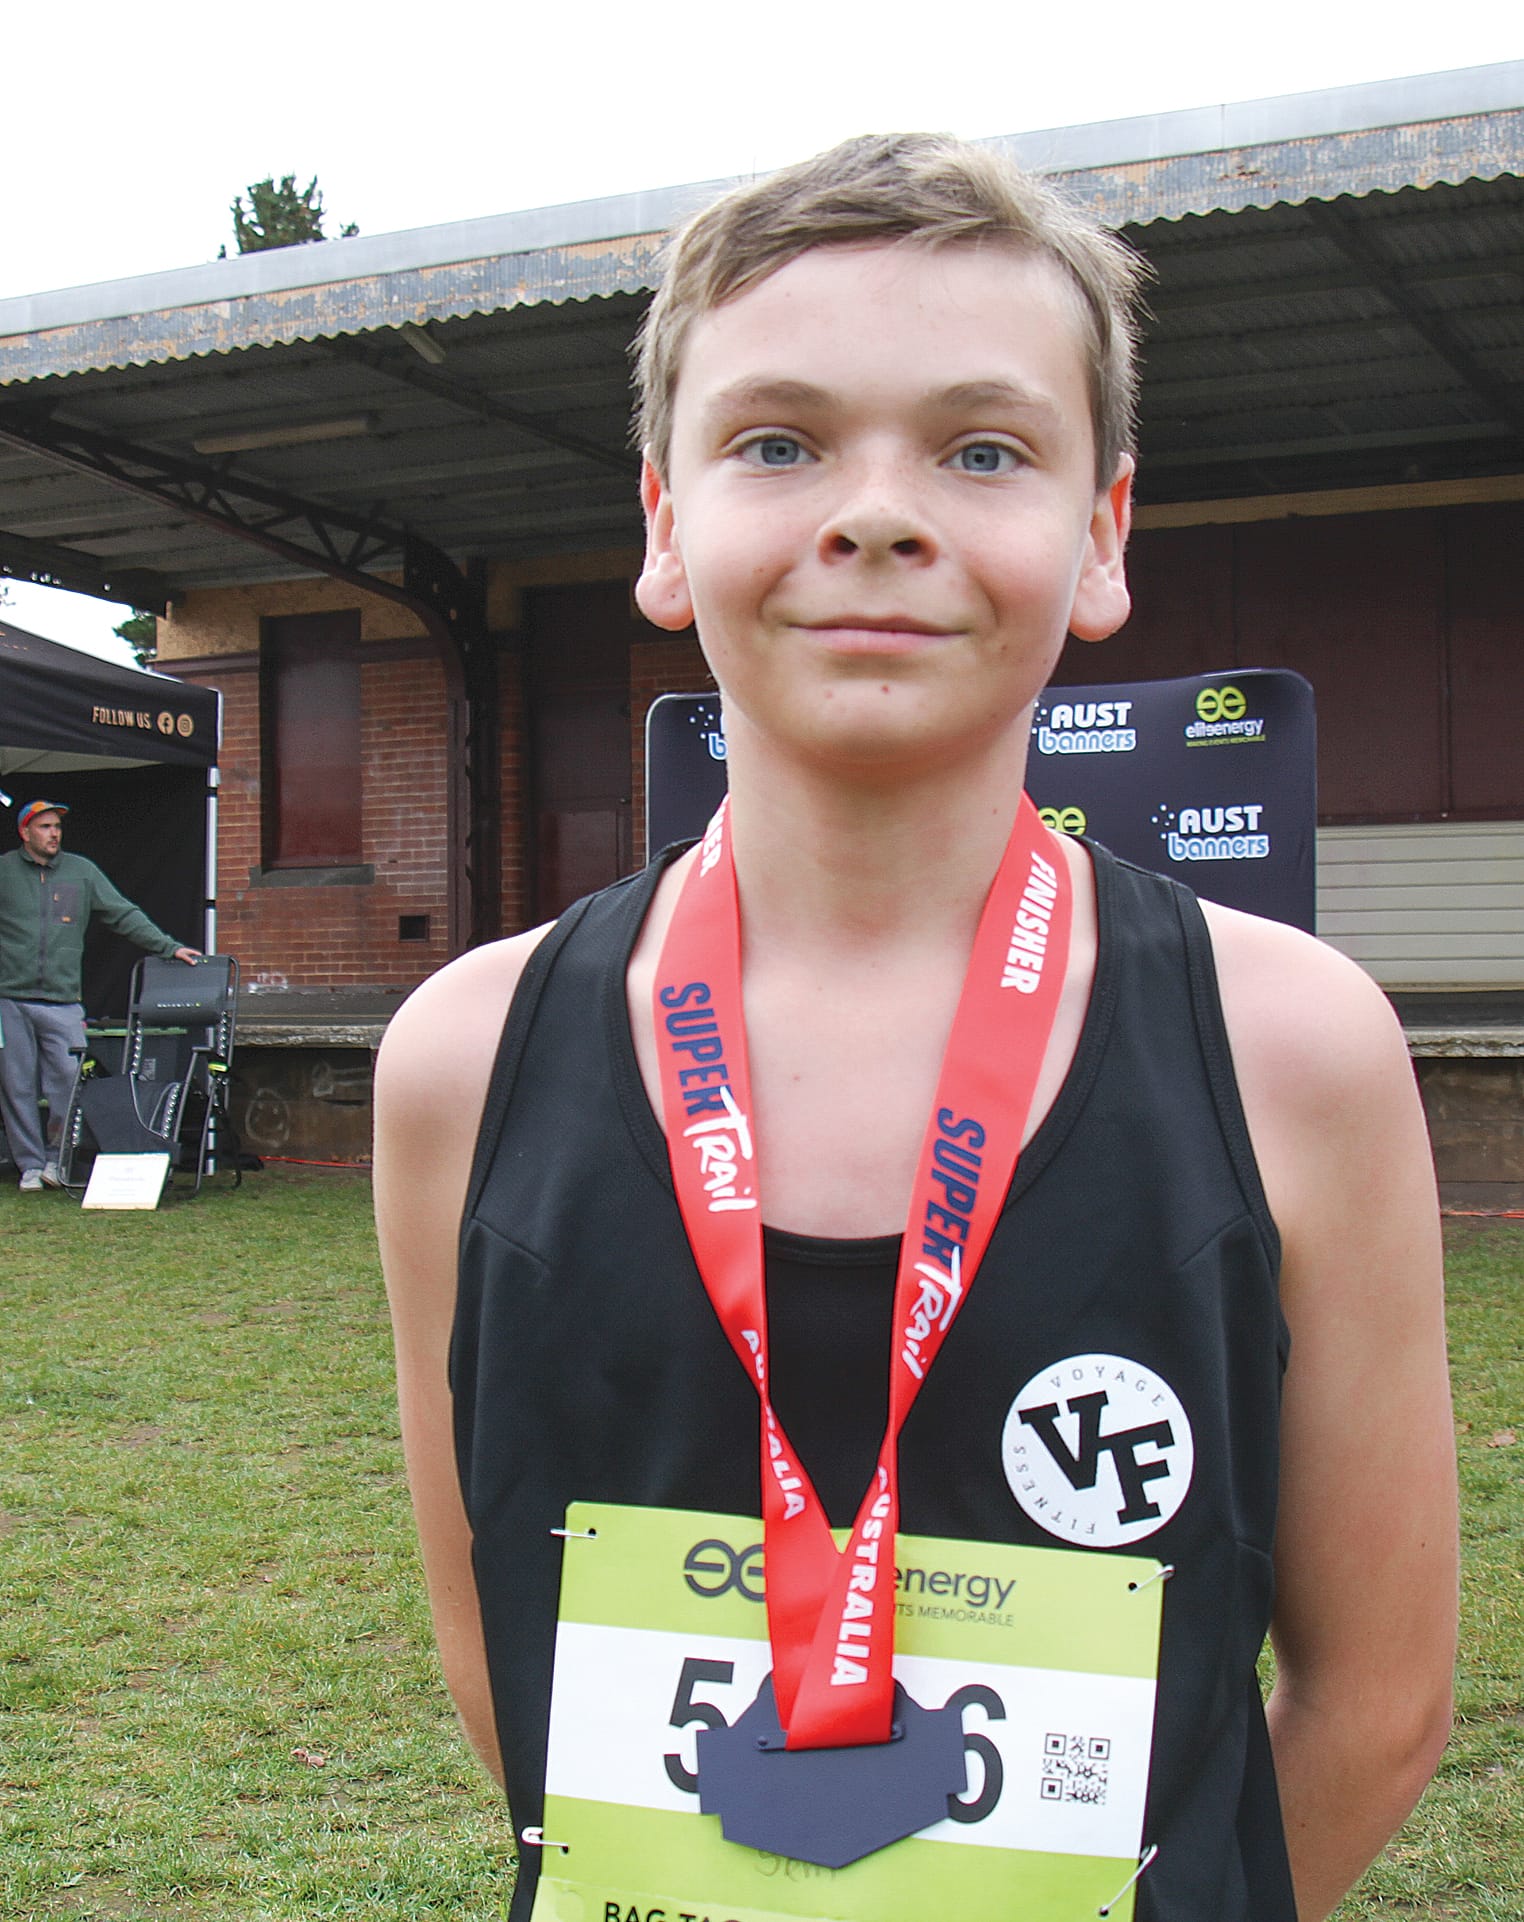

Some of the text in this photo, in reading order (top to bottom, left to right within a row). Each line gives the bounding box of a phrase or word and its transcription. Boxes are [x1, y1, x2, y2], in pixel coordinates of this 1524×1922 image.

[92, 706, 151, 729] FOLLOW US
[1051, 702, 1132, 729] AUST
[1038, 727, 1136, 754] banners
[1179, 805, 1263, 834] AUST
[1167, 832, 1269, 861] banners
[1000, 851, 1058, 994] FINISHER
[660, 982, 734, 1117] SUPER
[922, 1107, 986, 1272] SUPER
[1050, 1366, 1166, 1407] VOYAGE
[1018, 1389, 1175, 1526] VF
[1013, 1445, 1097, 1535] FITNESS
[918, 1604, 1015, 1628] MEMORABLE
